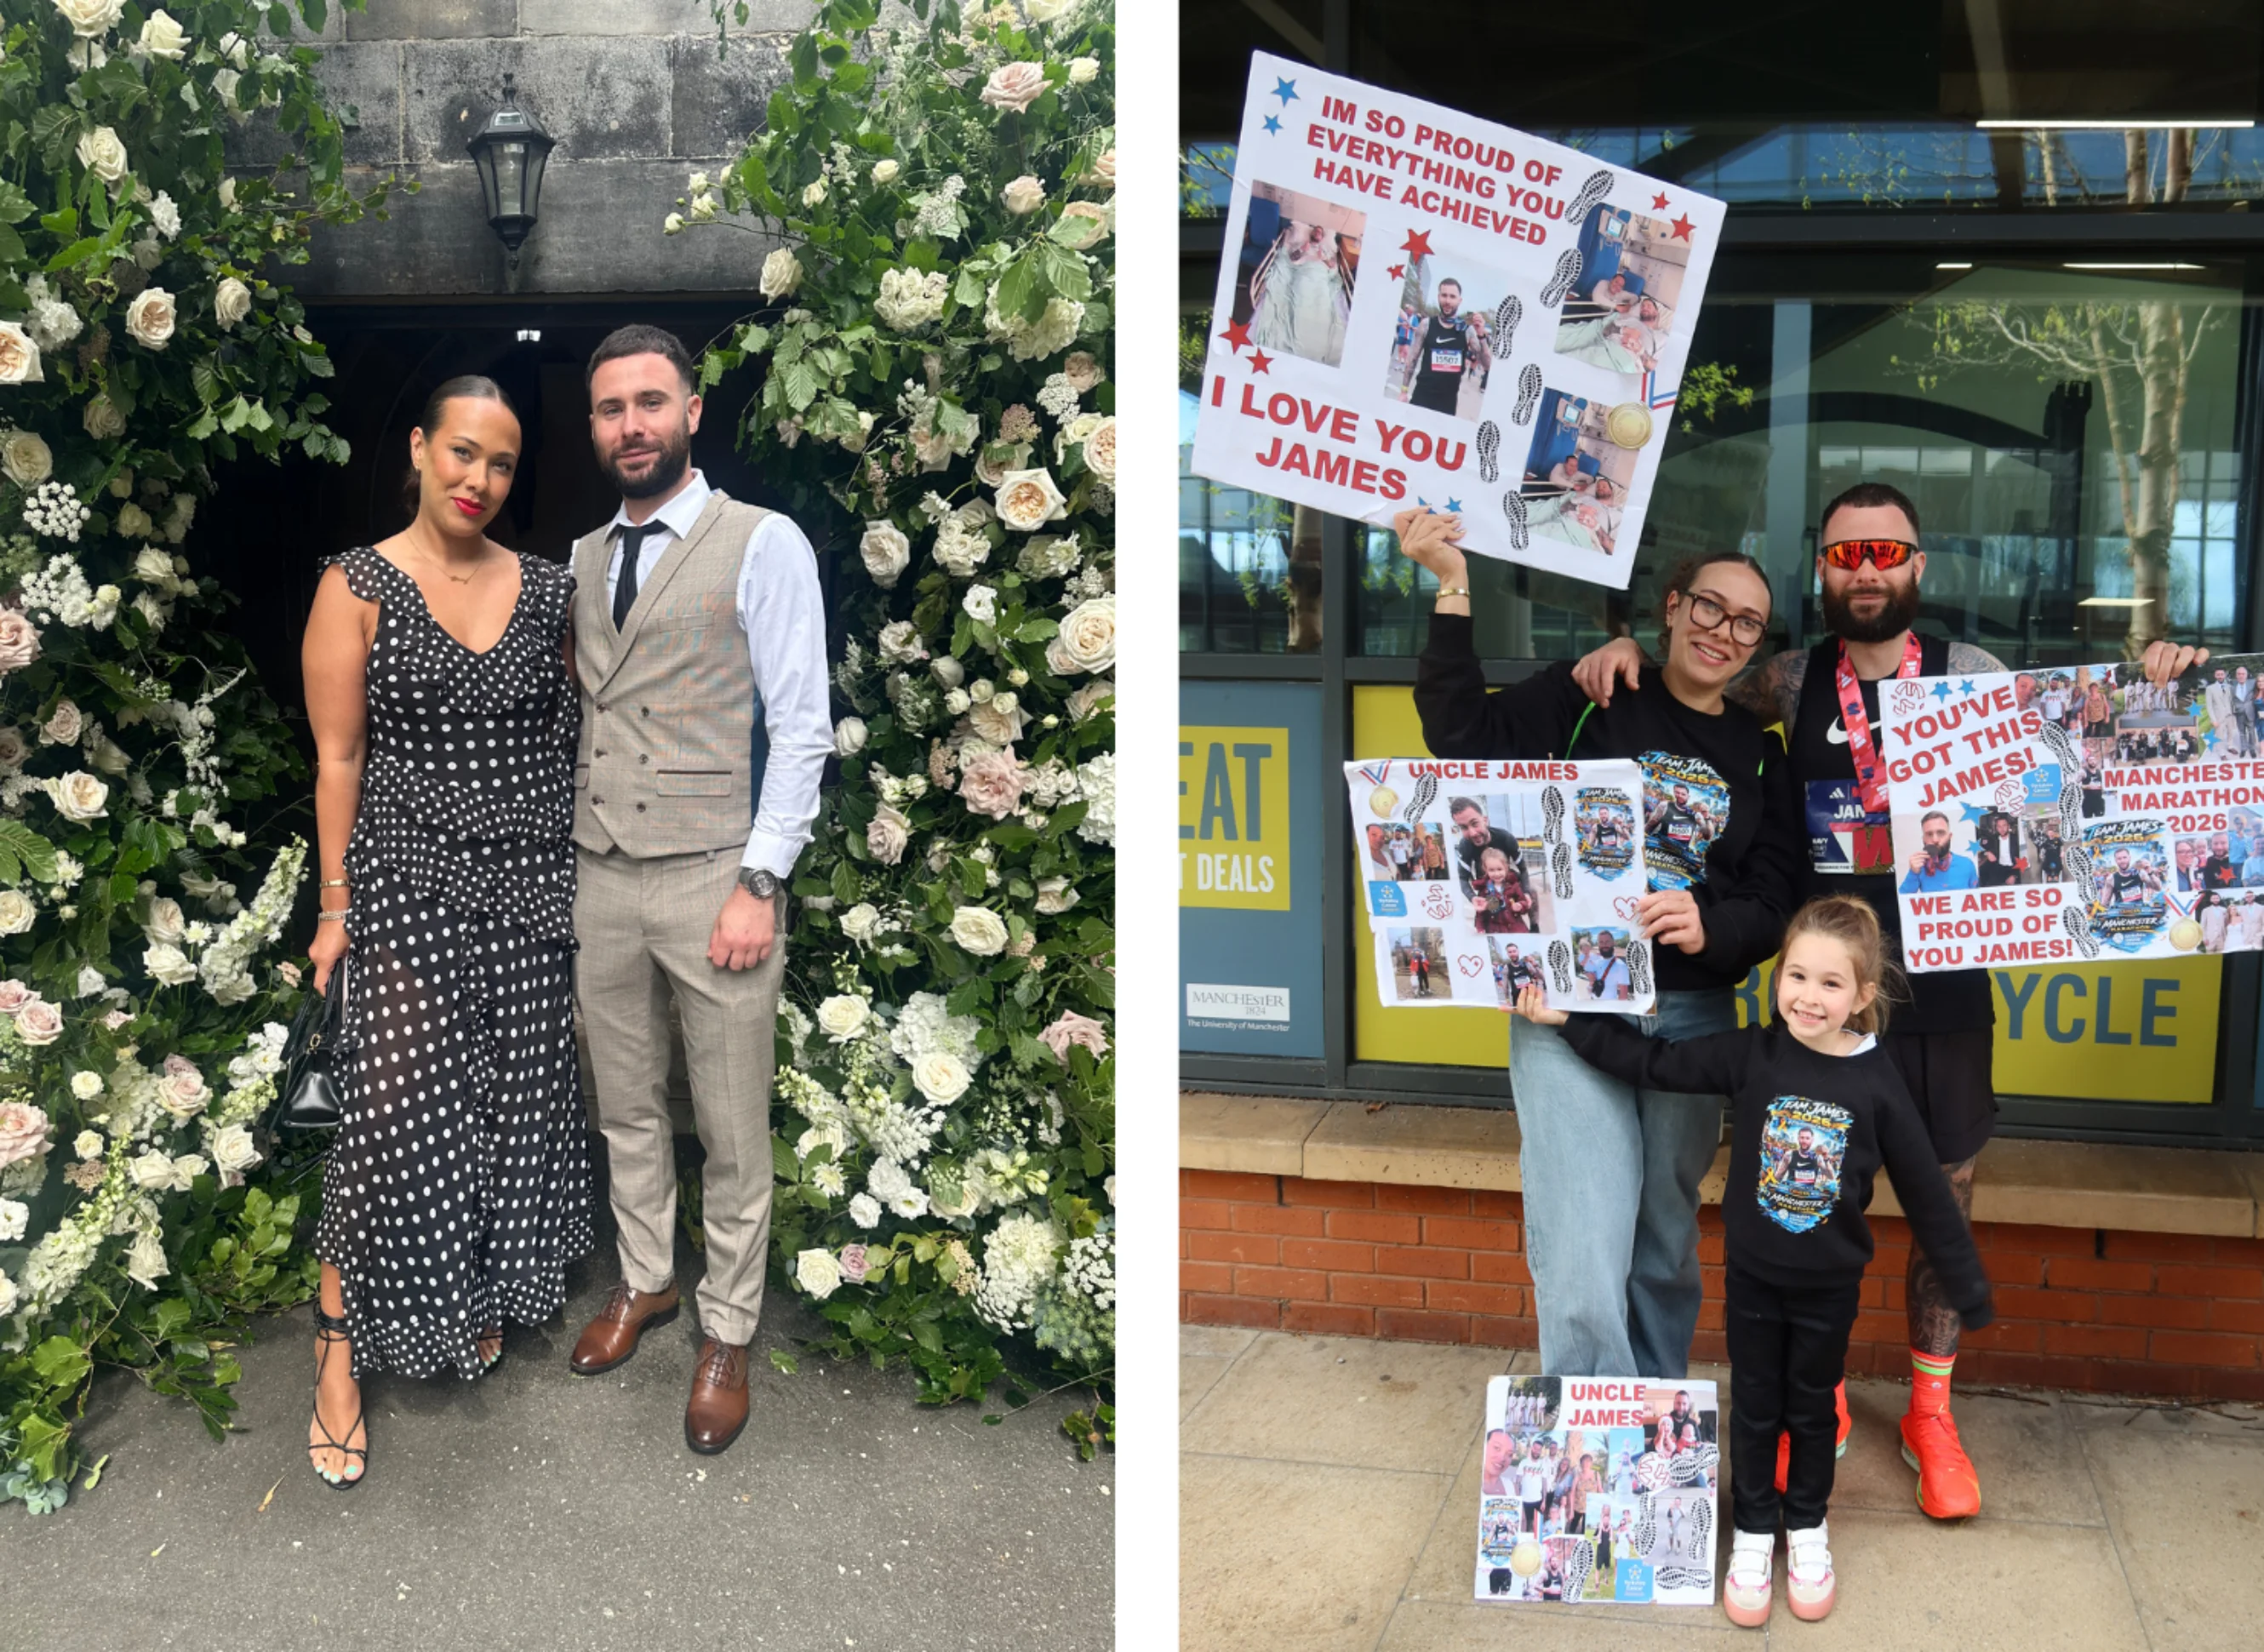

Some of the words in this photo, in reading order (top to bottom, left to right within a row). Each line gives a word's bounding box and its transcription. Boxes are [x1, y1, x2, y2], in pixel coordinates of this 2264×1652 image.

[1322, 96, 1356, 124] IM
[1365, 110, 1405, 138] SO
[1414, 124, 1515, 172] PROUD
[1524, 160, 1562, 187] OF
[1307, 123, 1495, 198] EVERYTHING
[1506, 184, 1565, 220] YOU
[1313, 157, 1393, 200] HAVE
[1400, 185, 1547, 246] ACHIEVED
[1211, 375, 1226, 407] I
[1240, 383, 1359, 443] LOVE
[1375, 420, 1466, 471] YOU
[1255, 437, 1407, 500] JAMES
[1891, 686, 2015, 746] YOU'VE
[1888, 741, 1952, 783] GOT
[1962, 711, 2043, 756] THIS
[1409, 762, 1489, 780] UNCLE
[1497, 762, 1580, 781] JAMES
[1665, 767, 1710, 784] 2026
[1918, 747, 2037, 808] JAMES!
[2122, 786, 2264, 811] MARATHON
[2167, 813, 2227, 833] 2026
[1197, 853, 1275, 894] DEALS
[1910, 896, 1952, 917] WE
[1962, 891, 2015, 912] ARE
[2026, 888, 2062, 908] SO
[1918, 917, 2013, 941] PROUD
[2022, 914, 2057, 934] OF
[1908, 946, 1964, 968] YOU
[1974, 939, 2073, 963] JAMES!
[1192, 991, 1284, 1008] MANCHESTER
[1245, 1005, 1266, 1016] 1824
[1993, 970, 2181, 1048] YCLE
[1187, 1018, 1201, 1028] The
[1202, 1020, 1238, 1032] University
[1238, 1020, 1246, 1029] of
[1246, 1022, 1289, 1032] Manchester
[1778, 1095, 1809, 1111] TEAM
[1792, 1111, 1832, 1128] 2026
[1570, 1384, 1647, 1403] UNCLE
[1568, 1409, 1644, 1427] JAMES
